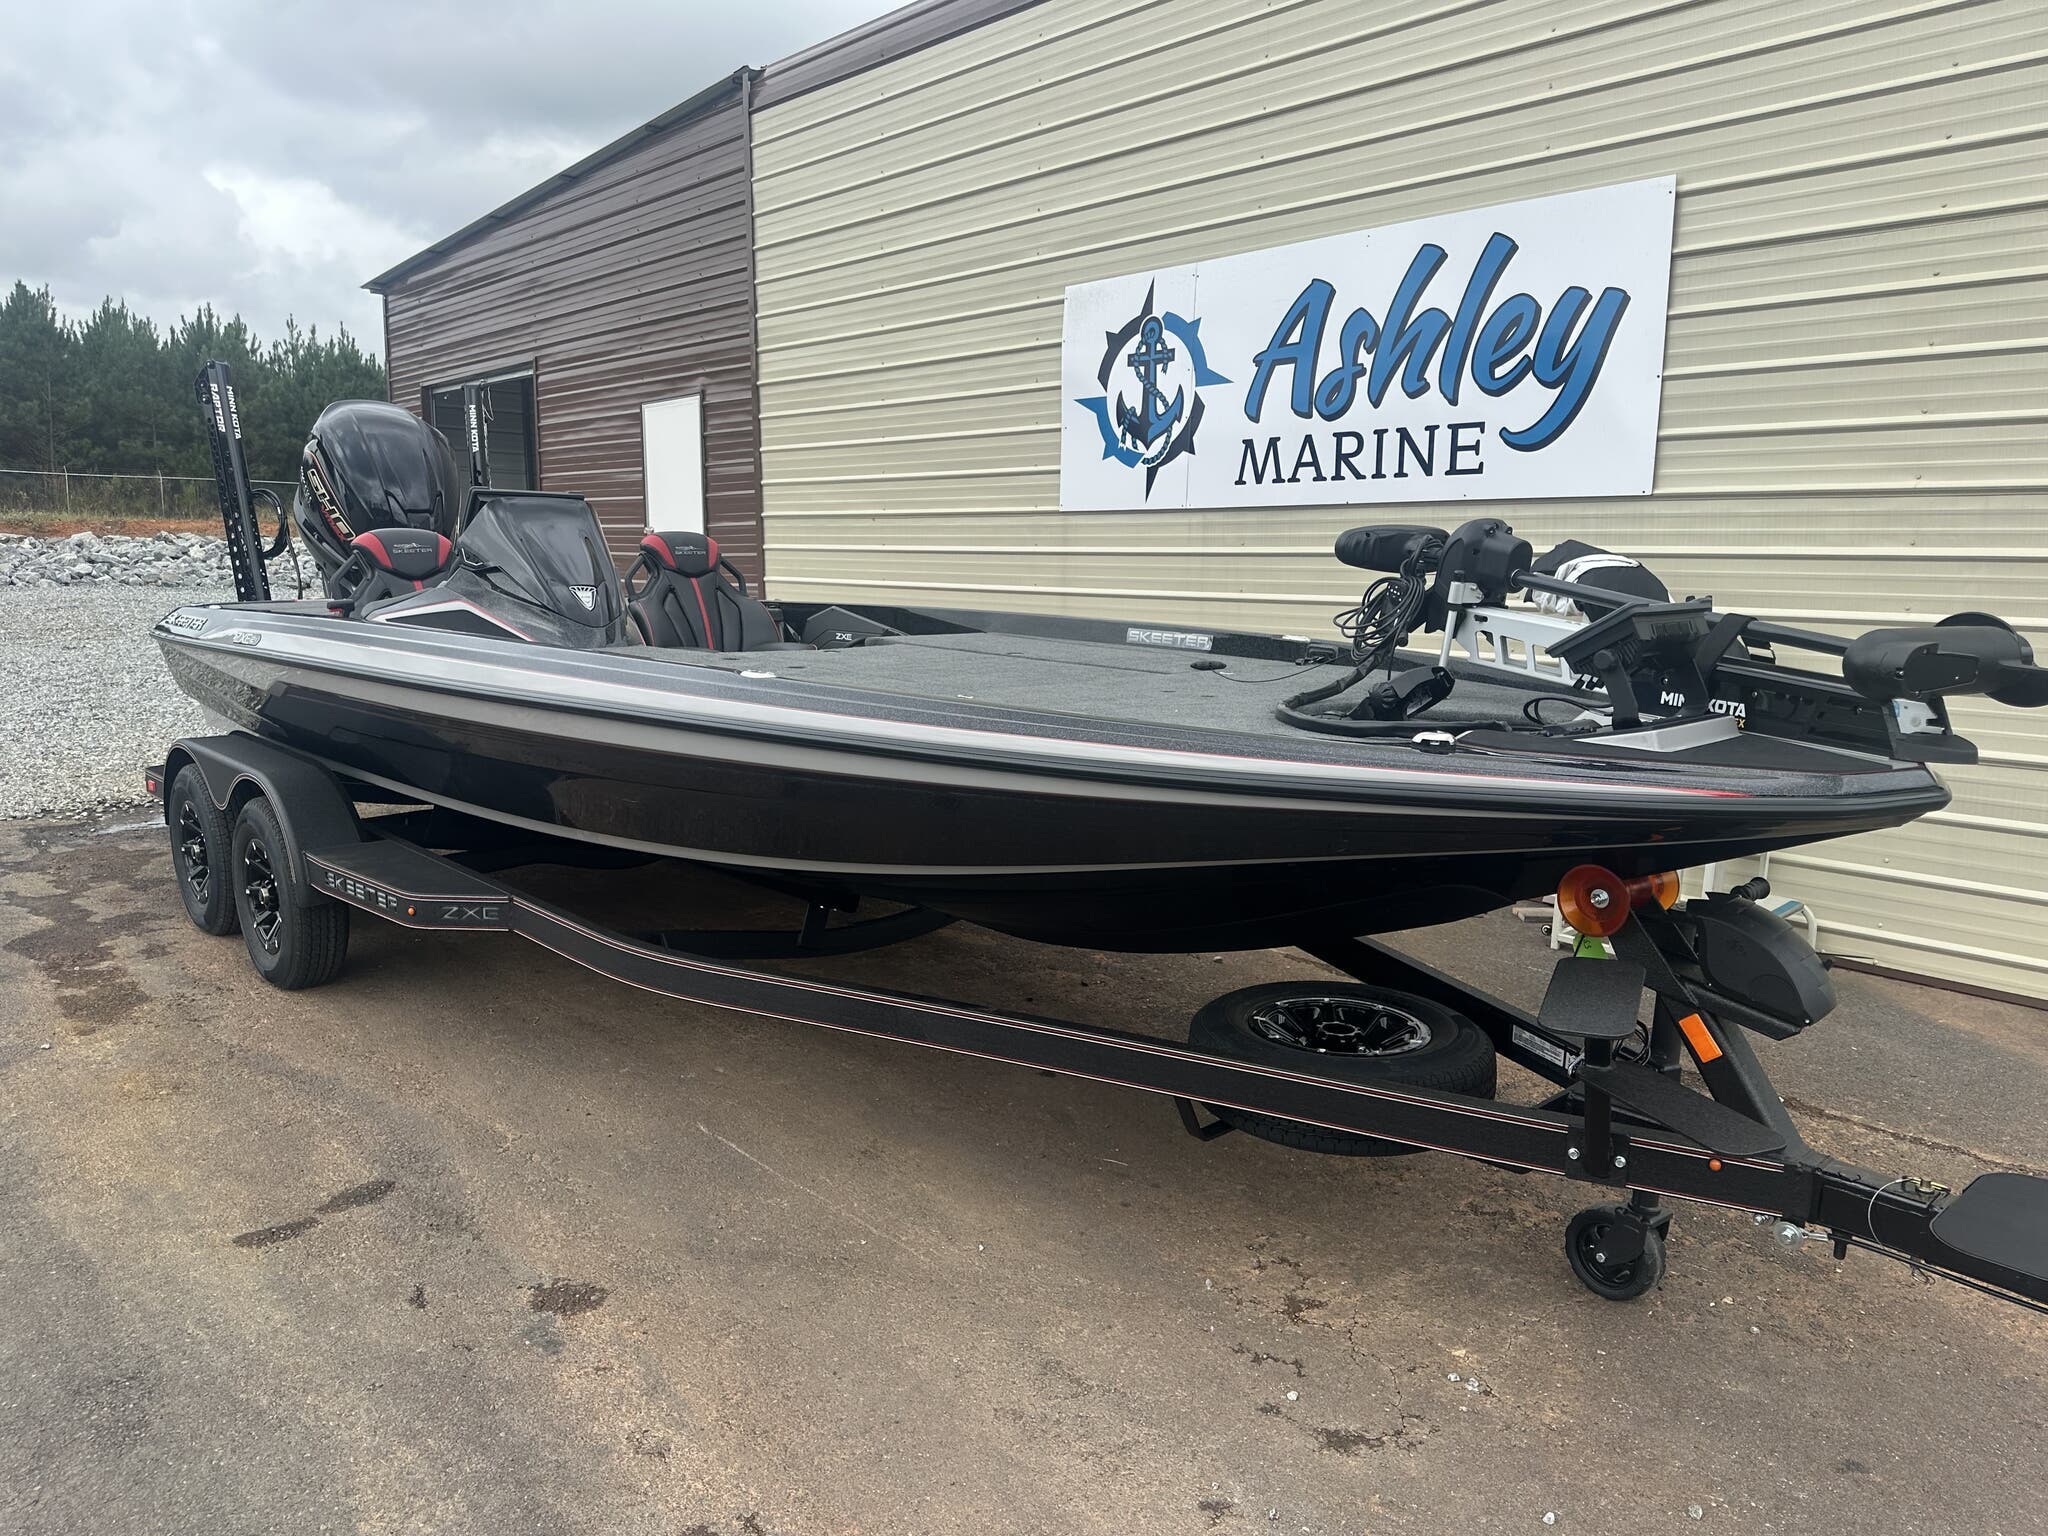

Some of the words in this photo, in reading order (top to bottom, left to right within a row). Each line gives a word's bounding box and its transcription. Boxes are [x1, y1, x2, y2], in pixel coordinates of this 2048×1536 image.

[1245, 232, 1631, 453] Ashley
[210, 383, 226, 433] RAPTOR
[226, 385, 237, 412] MINN
[231, 413, 242, 439] KOTA
[469, 404, 478, 428] MINN
[471, 429, 480, 453] KOTA
[1234, 421, 1486, 486] MARINE
[835, 632, 853, 641] ZXE
[1128, 631, 1210, 648] SKEETER
[1660, 691, 1686, 707] MIN
[326, 872, 399, 913] SKEETER
[441, 906, 500, 920] ZXE
